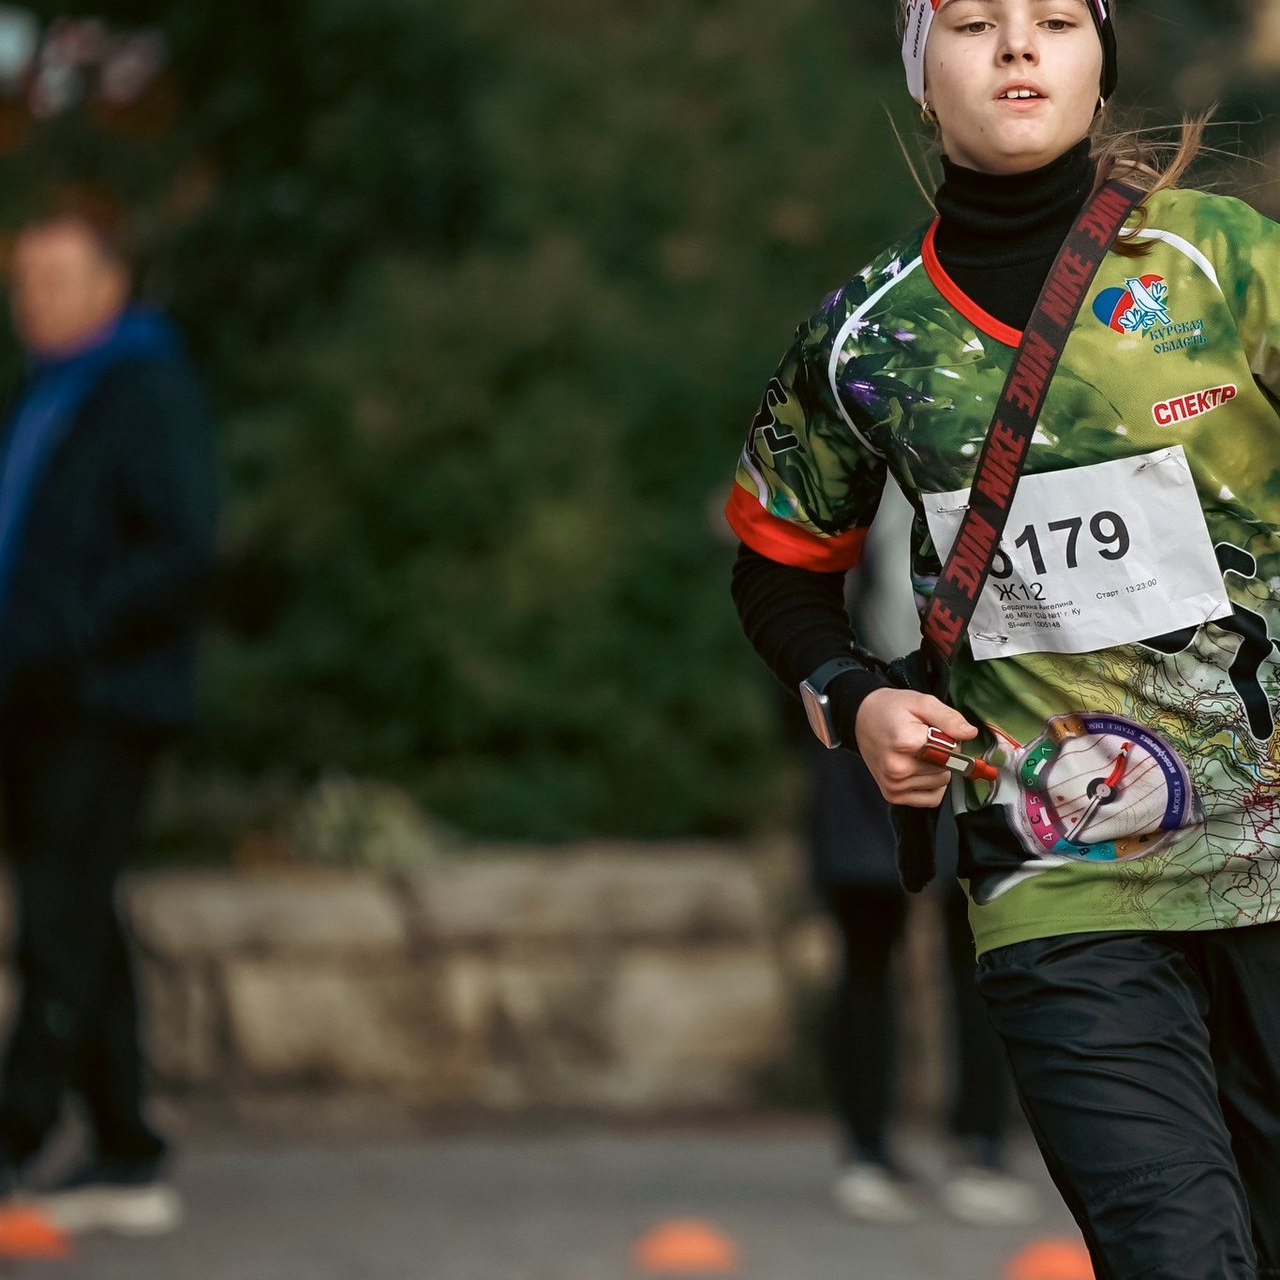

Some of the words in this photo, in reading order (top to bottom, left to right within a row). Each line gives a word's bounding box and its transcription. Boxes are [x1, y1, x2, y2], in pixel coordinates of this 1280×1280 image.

[1076, 188, 1131, 247] NIKE
[1040, 246, 1094, 327] NIKE
[1154, 334, 1207, 354] ОБЛАСТЬ
[1006, 331, 1057, 418] NIKE
[1153, 385, 1236, 425] СПЕКТР
[977, 420, 1025, 510] NIKE
[946, 509, 997, 600] NIKE
[993, 582, 1046, 601] Ж12
[1039, 600, 1074, 610] Ангелина
[1096, 590, 1119, 600] Старт
[1125, 578, 1157, 594] 13:23:00
[1172, 786, 1182, 816] MODEL
